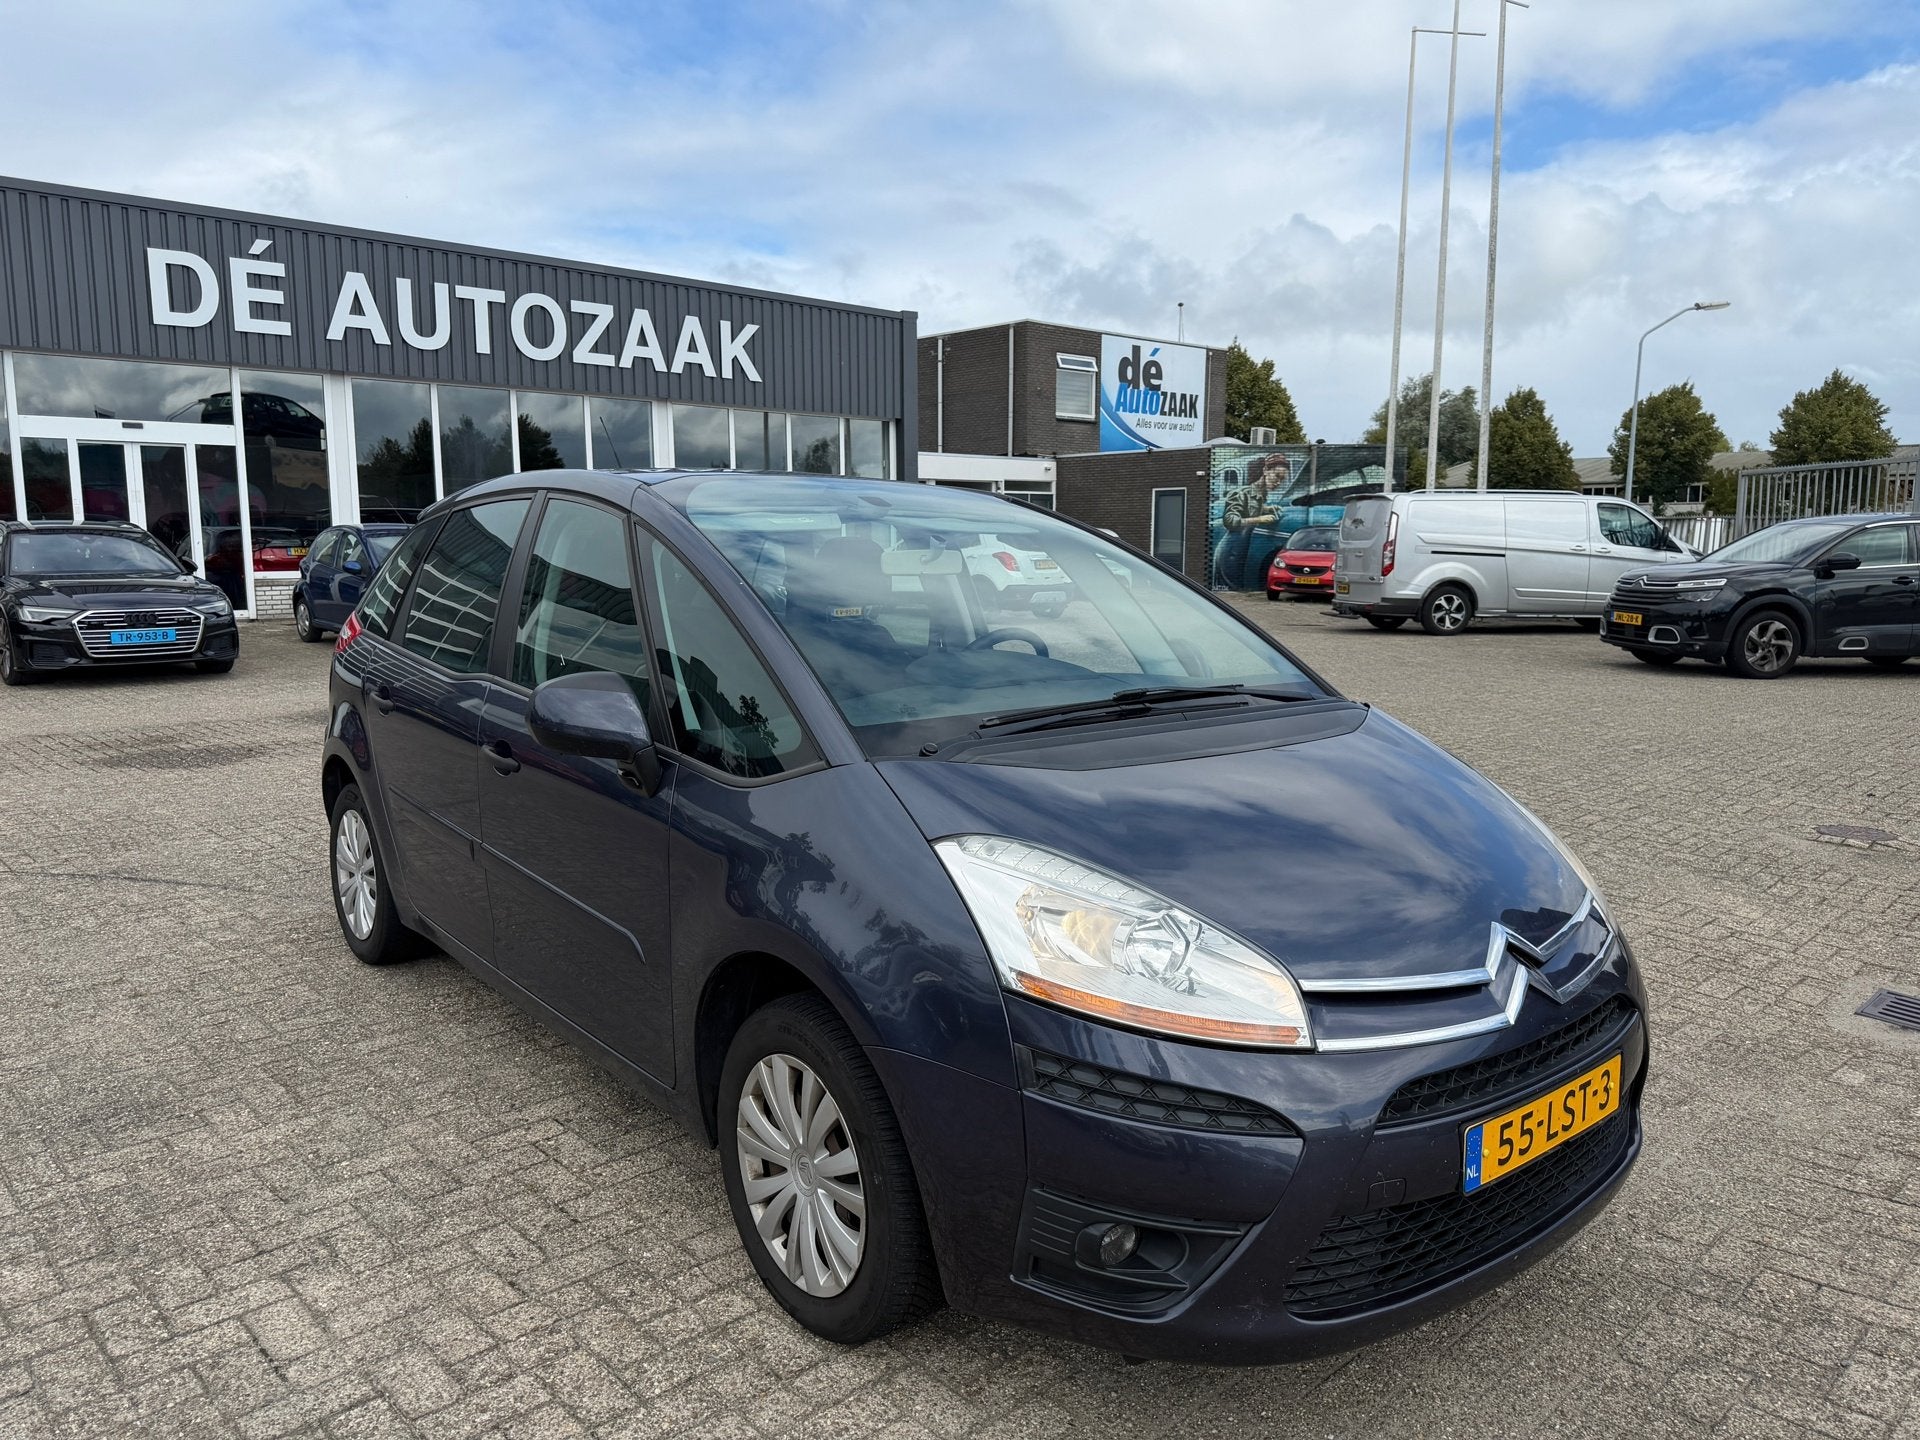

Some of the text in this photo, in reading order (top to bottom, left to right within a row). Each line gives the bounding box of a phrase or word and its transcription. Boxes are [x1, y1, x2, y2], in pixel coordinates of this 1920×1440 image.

[147, 239, 763, 382] DÉ AUTOZAAK
[1119, 345, 1162, 391] dé
[1136, 418, 1194, 431] Alles voor uw auto!
[118, 631, 169, 642] TR-953-B
[1497, 1069, 1611, 1166] 55-LST-3
[1466, 1164, 1479, 1180] NL
